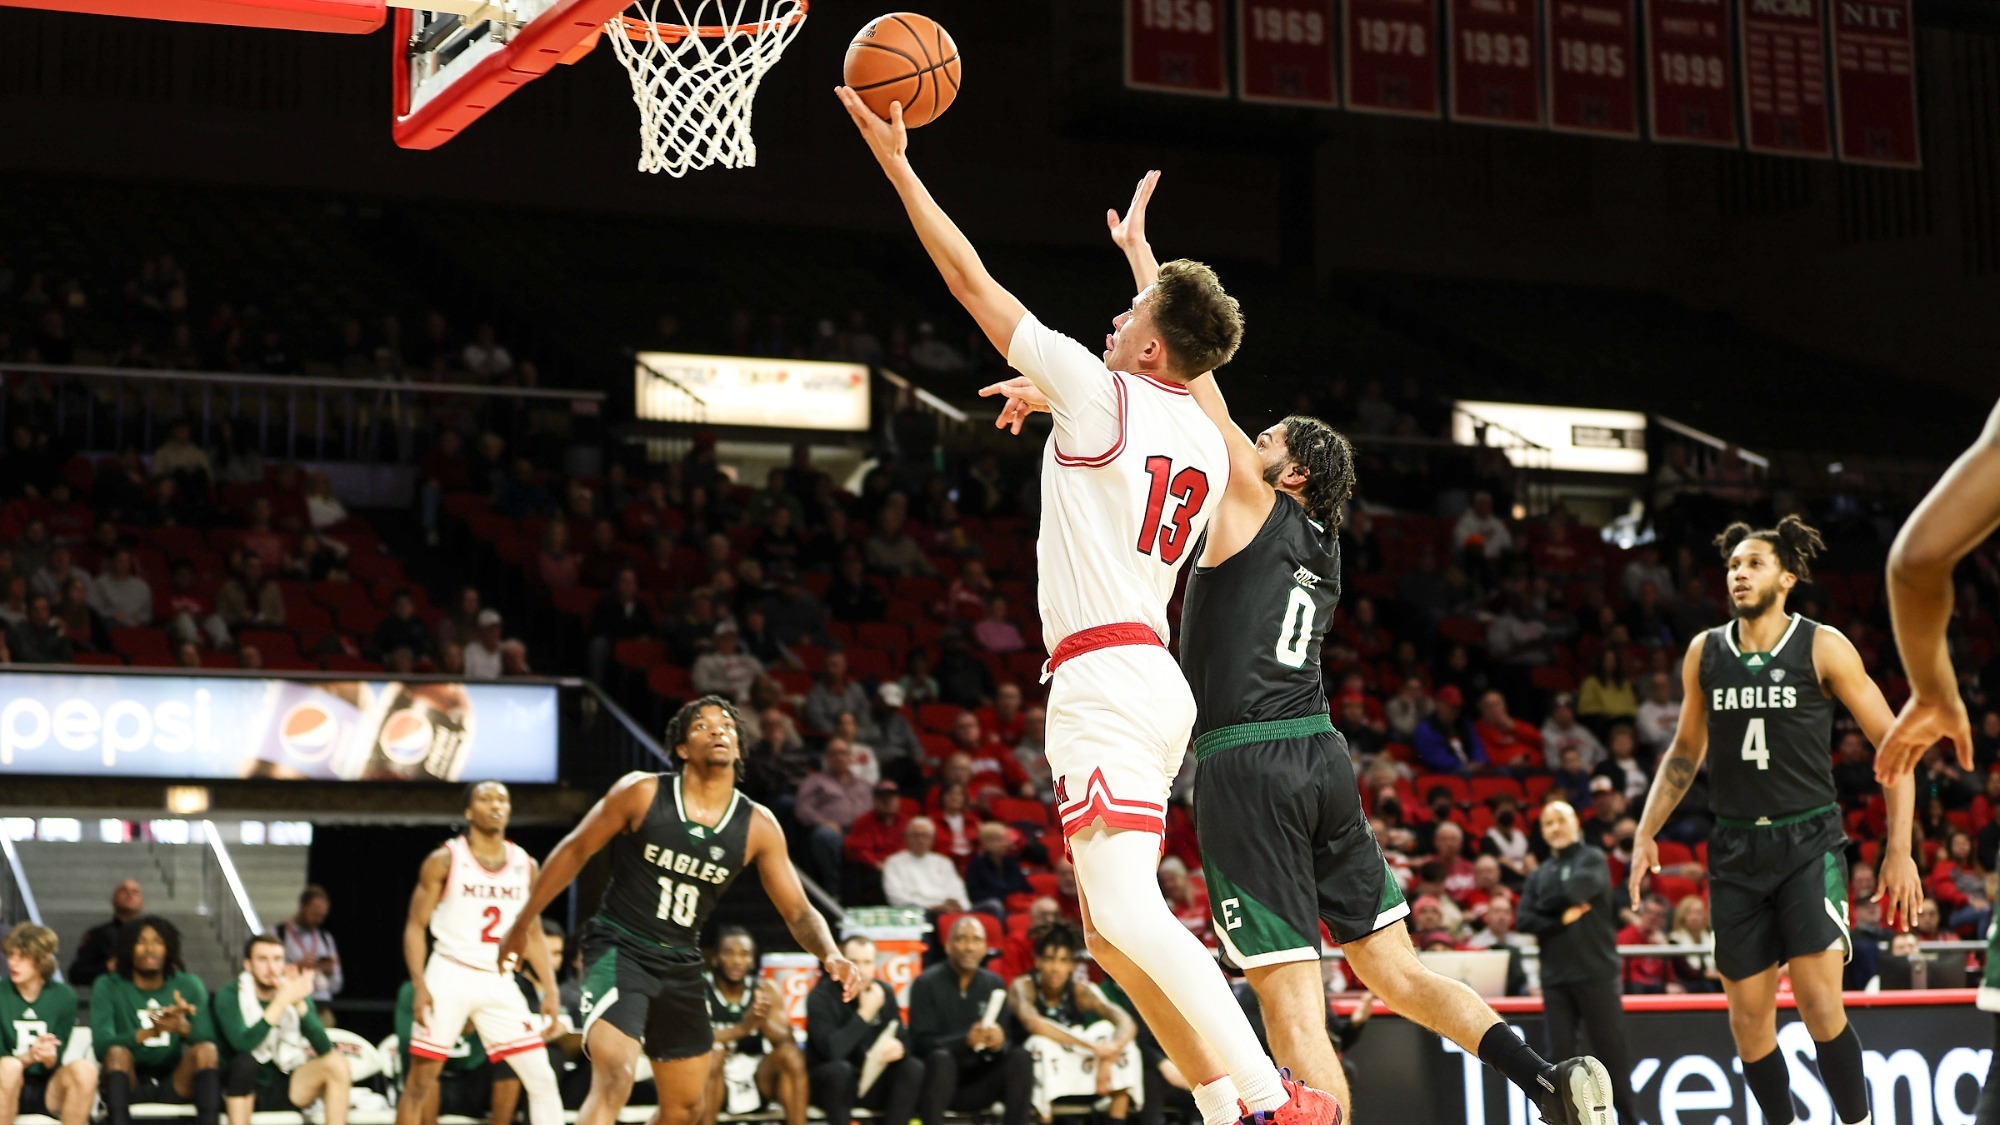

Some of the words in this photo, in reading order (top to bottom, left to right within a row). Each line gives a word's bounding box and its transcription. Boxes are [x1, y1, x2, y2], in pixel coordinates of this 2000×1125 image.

[1143, 0, 1214, 33] 1958
[1251, 8, 1325, 45] 1969
[1842, 4, 1902, 29] NIT
[1358, 18, 1427, 57] 1978
[1462, 28, 1531, 68] 1993
[1559, 37, 1625, 79] 1995
[1660, 51, 1725, 90] 1999
[1137, 455, 1209, 566] 13
[1275, 584, 1316, 669] 0
[1713, 686, 1797, 711] EAGLES
[0, 687, 219, 767] pepsi
[1741, 718, 1770, 770] 4
[643, 843, 730, 885] EAGLES
[463, 884, 521, 899] MIAMI
[656, 876, 700, 928] 10
[481, 906, 502, 943] 2
[1221, 897, 1243, 932] E
[786, 973, 809, 996] G
[887, 956, 913, 982] G
